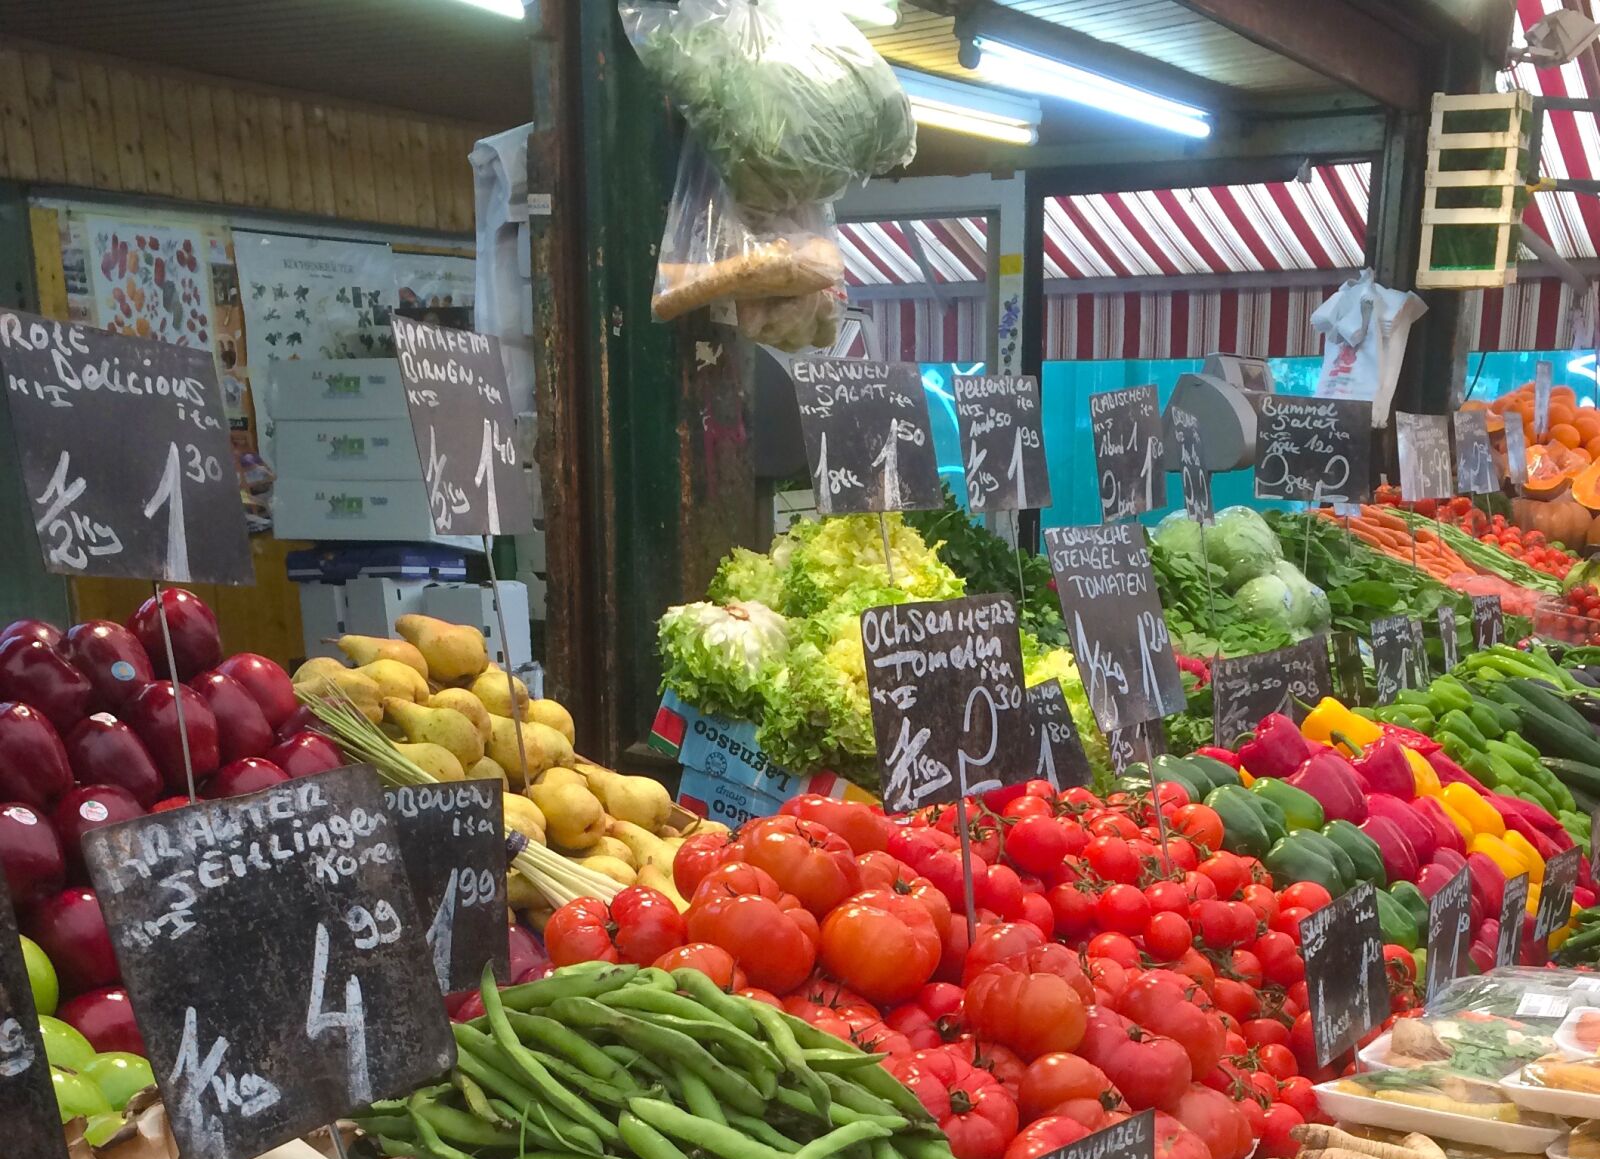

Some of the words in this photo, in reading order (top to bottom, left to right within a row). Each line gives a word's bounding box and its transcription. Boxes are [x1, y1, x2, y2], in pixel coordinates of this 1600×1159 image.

[51, 347, 206, 407] Delicious
[1262, 396, 1339, 417] Bummel
[1054, 547, 1120, 573] STENGEL
[1068, 573, 1147, 599] TOMATEN
[694, 720, 791, 793] Lagnasco
[715, 786, 747, 806] Group
